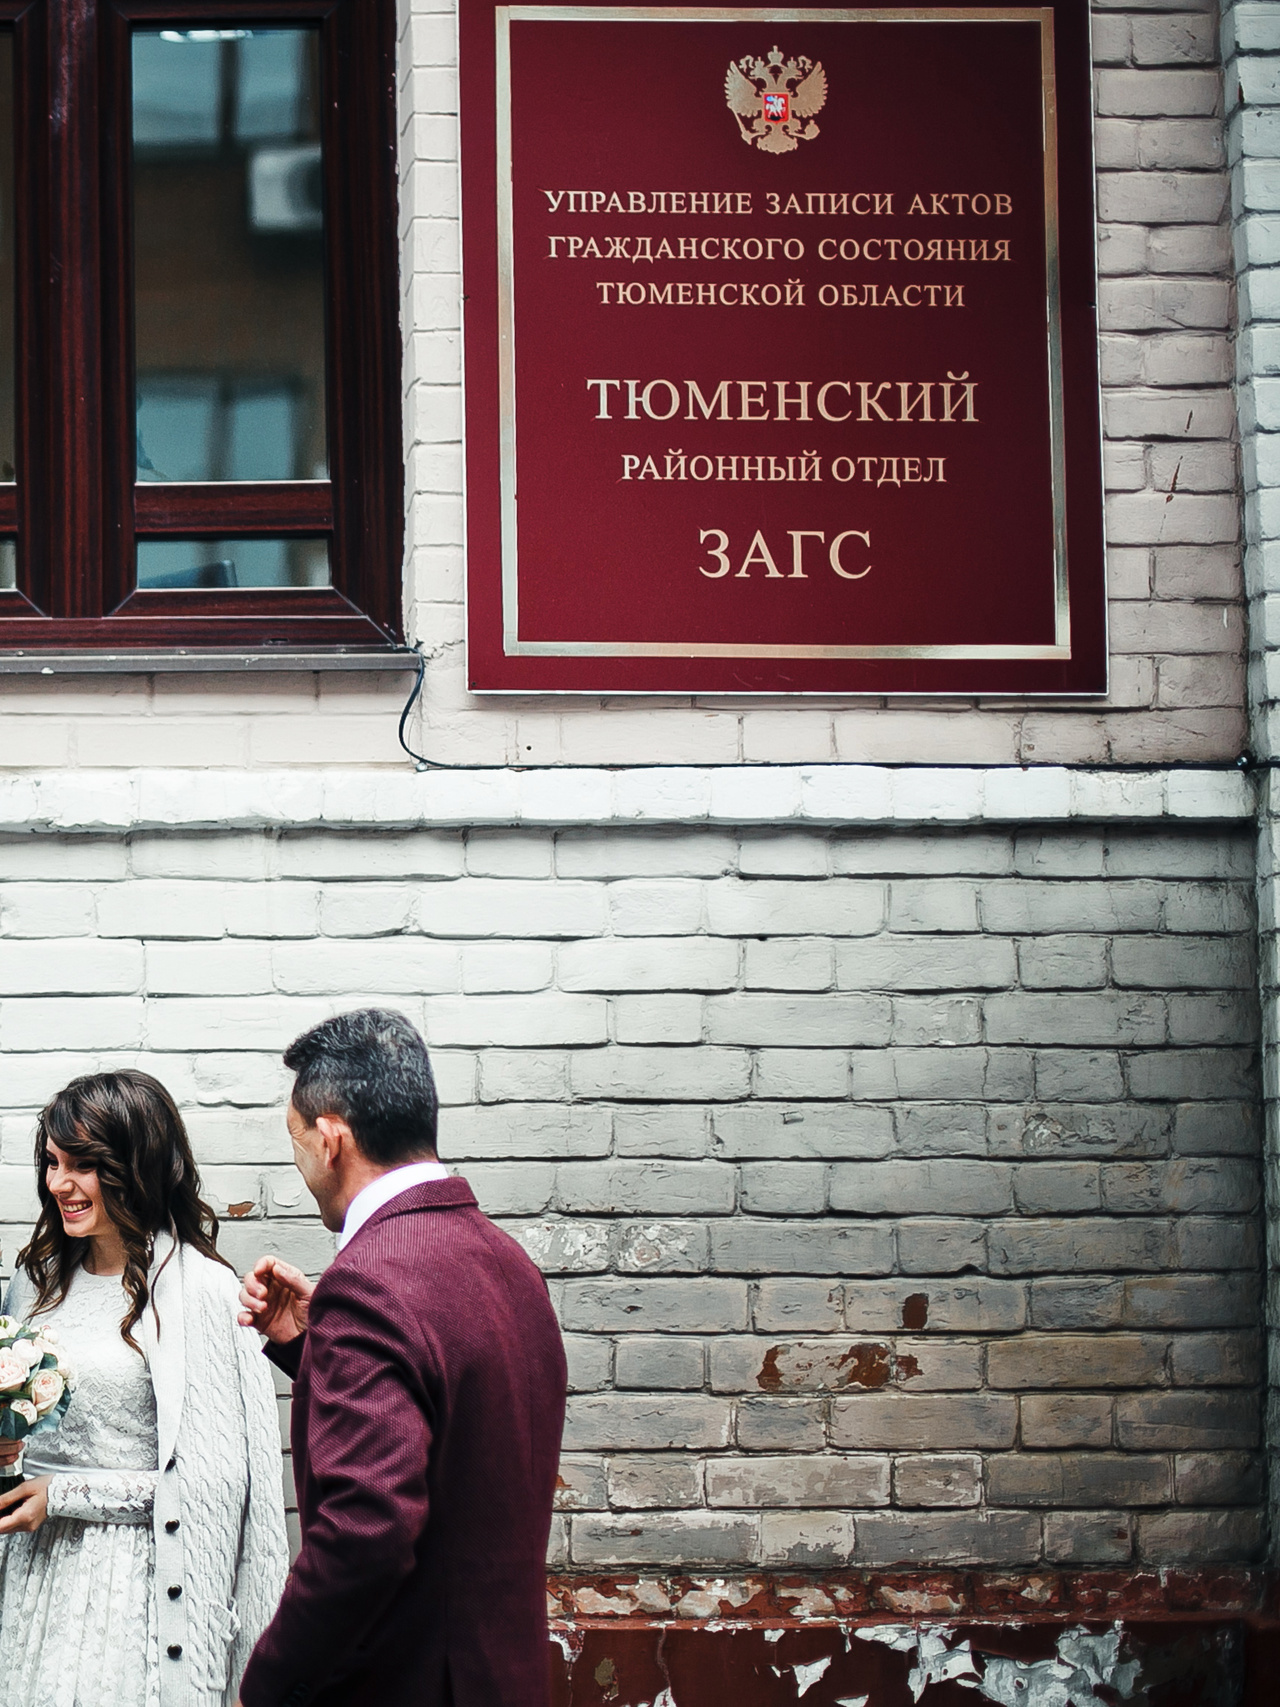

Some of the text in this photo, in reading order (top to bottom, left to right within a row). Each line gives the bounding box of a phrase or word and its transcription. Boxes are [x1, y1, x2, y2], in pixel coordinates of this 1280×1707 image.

[544, 191, 1012, 214] УПРАВЛЕНИЕ ЗАПИСИ АКТОВ
[549, 236, 1009, 263] ГРАЖДАНСКОГО СОСТОЯНИЯ
[597, 279, 963, 306] ТЮМЕНСКОЙ ОБЛАСТИ
[587, 371, 978, 421] ТЮМЕНСКИЙ
[622, 449, 946, 487] РАЙОННЫЙ ОТДЕЛ
[699, 529, 871, 579] ЗАГС
